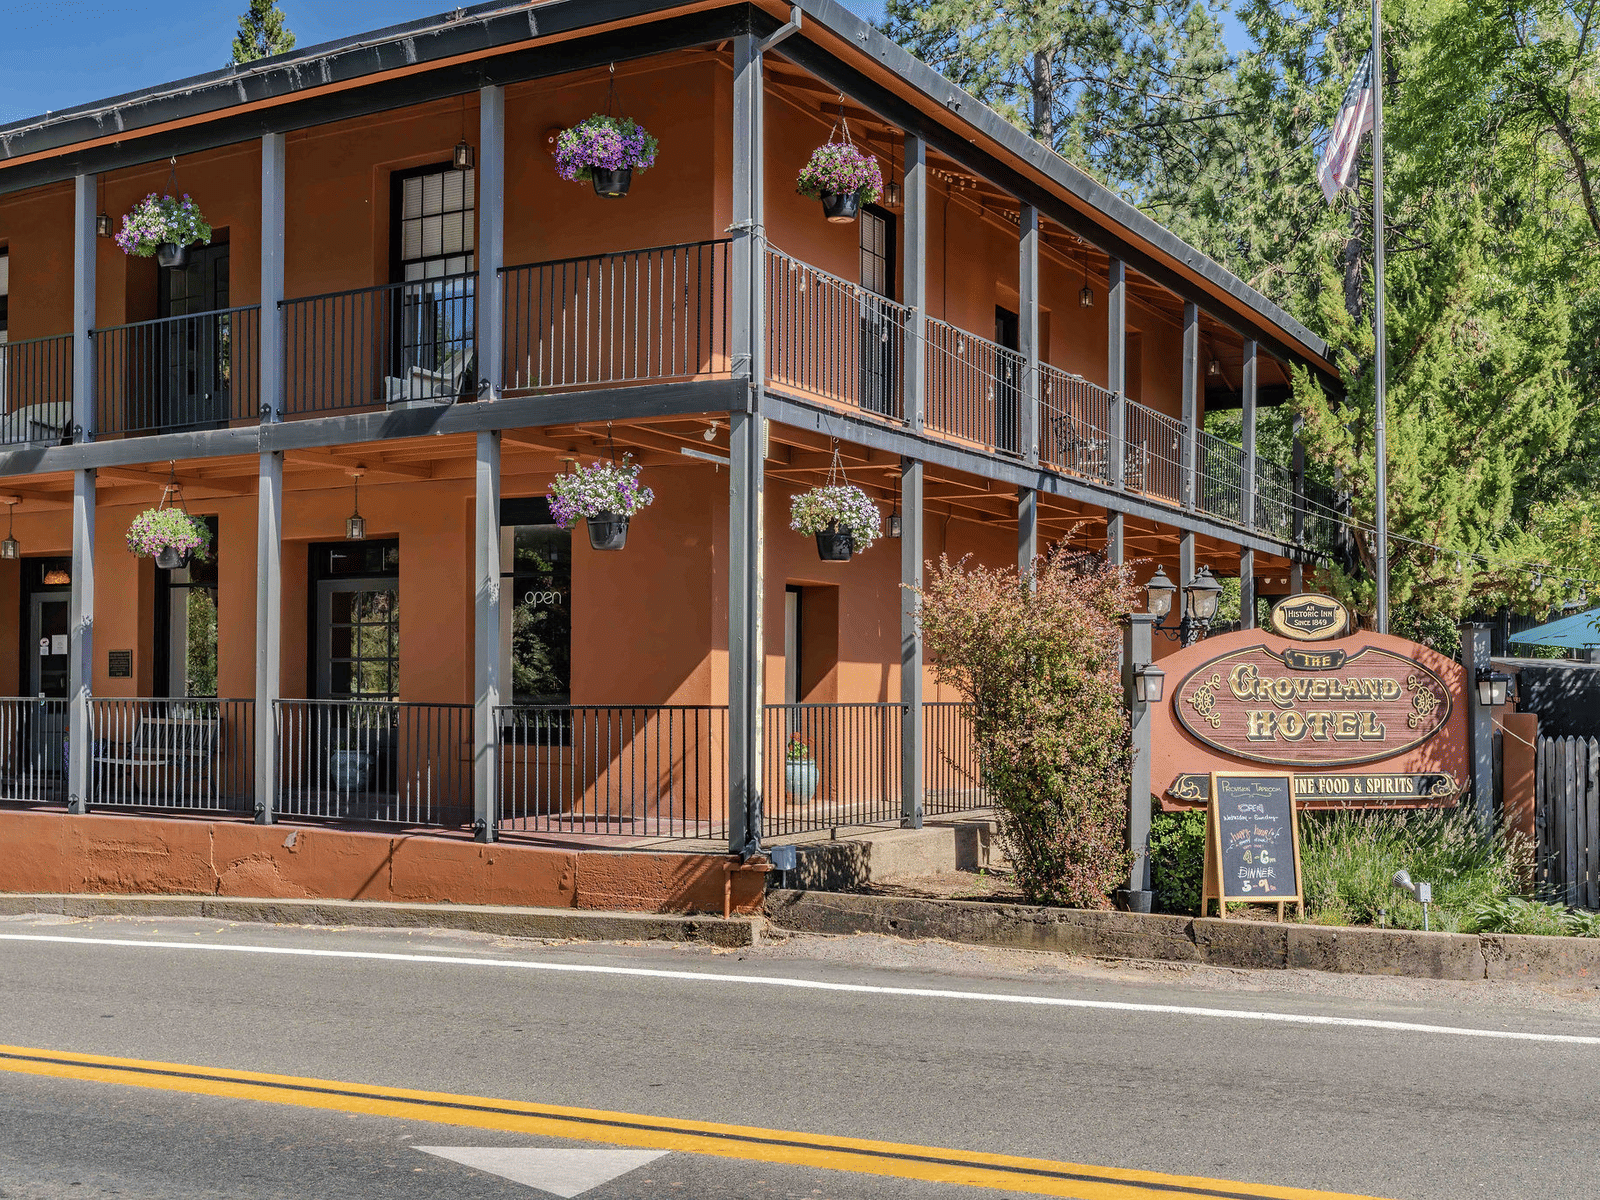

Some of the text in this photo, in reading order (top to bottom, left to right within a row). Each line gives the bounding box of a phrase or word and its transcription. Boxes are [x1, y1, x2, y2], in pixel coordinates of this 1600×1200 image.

[525, 591, 562, 608] open
[1288, 610, 1333, 618] HISTORIC INN
[1294, 653, 1332, 667] THE
[1227, 663, 1403, 709] GROVELAND
[1246, 710, 1387, 742] HOTEL
[1294, 778, 1414, 794] INE FOOD & SPIRITS
[1238, 803, 1264, 814] OPEN
[1237, 866, 1277, 879] DINNER
